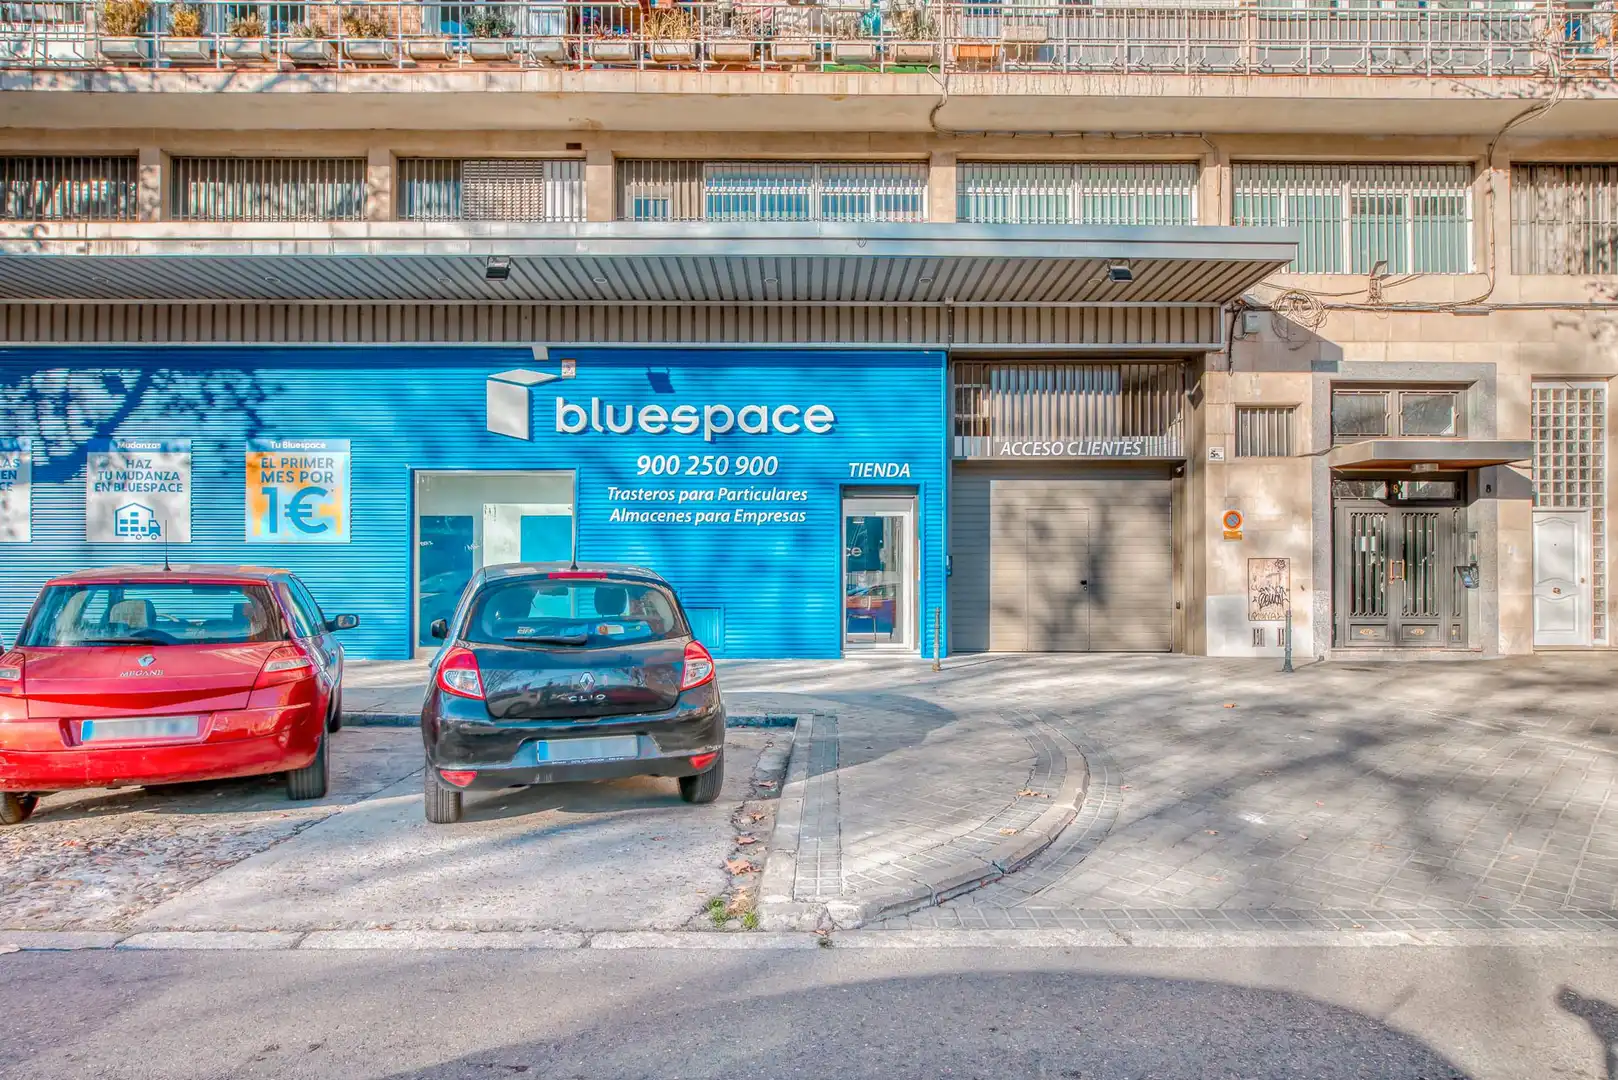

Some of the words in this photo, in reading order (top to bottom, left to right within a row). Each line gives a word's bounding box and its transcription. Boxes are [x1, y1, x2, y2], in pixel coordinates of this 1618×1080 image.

[556, 396, 835, 442] bluespace
[117, 441, 161, 449] Mudanzas
[271, 441, 281, 449] Tu
[283, 441, 326, 450] Bluespace
[1000, 441, 1064, 456] ACCESO
[1067, 441, 1142, 456] CLIENTES
[126, 459, 152, 469] HAZ
[261, 457, 276, 468] EL
[280, 457, 334, 468] PRIMER
[637, 455, 680, 475] 900
[685, 455, 729, 475] 250
[735, 455, 778, 475] 900
[849, 462, 911, 478] TIENDA
[98, 471, 113, 480] TU
[116, 471, 180, 481] MUDANZA
[261, 471, 295, 483] MES
[299, 471, 334, 483] POR
[95, 482, 110, 492] EN
[113, 482, 183, 492] BLUESPACE
[1485, 484, 1492, 494] 8
[607, 486, 675, 501] Trasteros
[678, 488, 714, 504] para
[717, 486, 808, 501] Particulares
[609, 508, 692, 522] Almacenes
[695, 512, 730, 526] para
[733, 508, 806, 526] Empresas
[120, 669, 164, 677] MEGANE
[568, 693, 606, 702] CLIO
